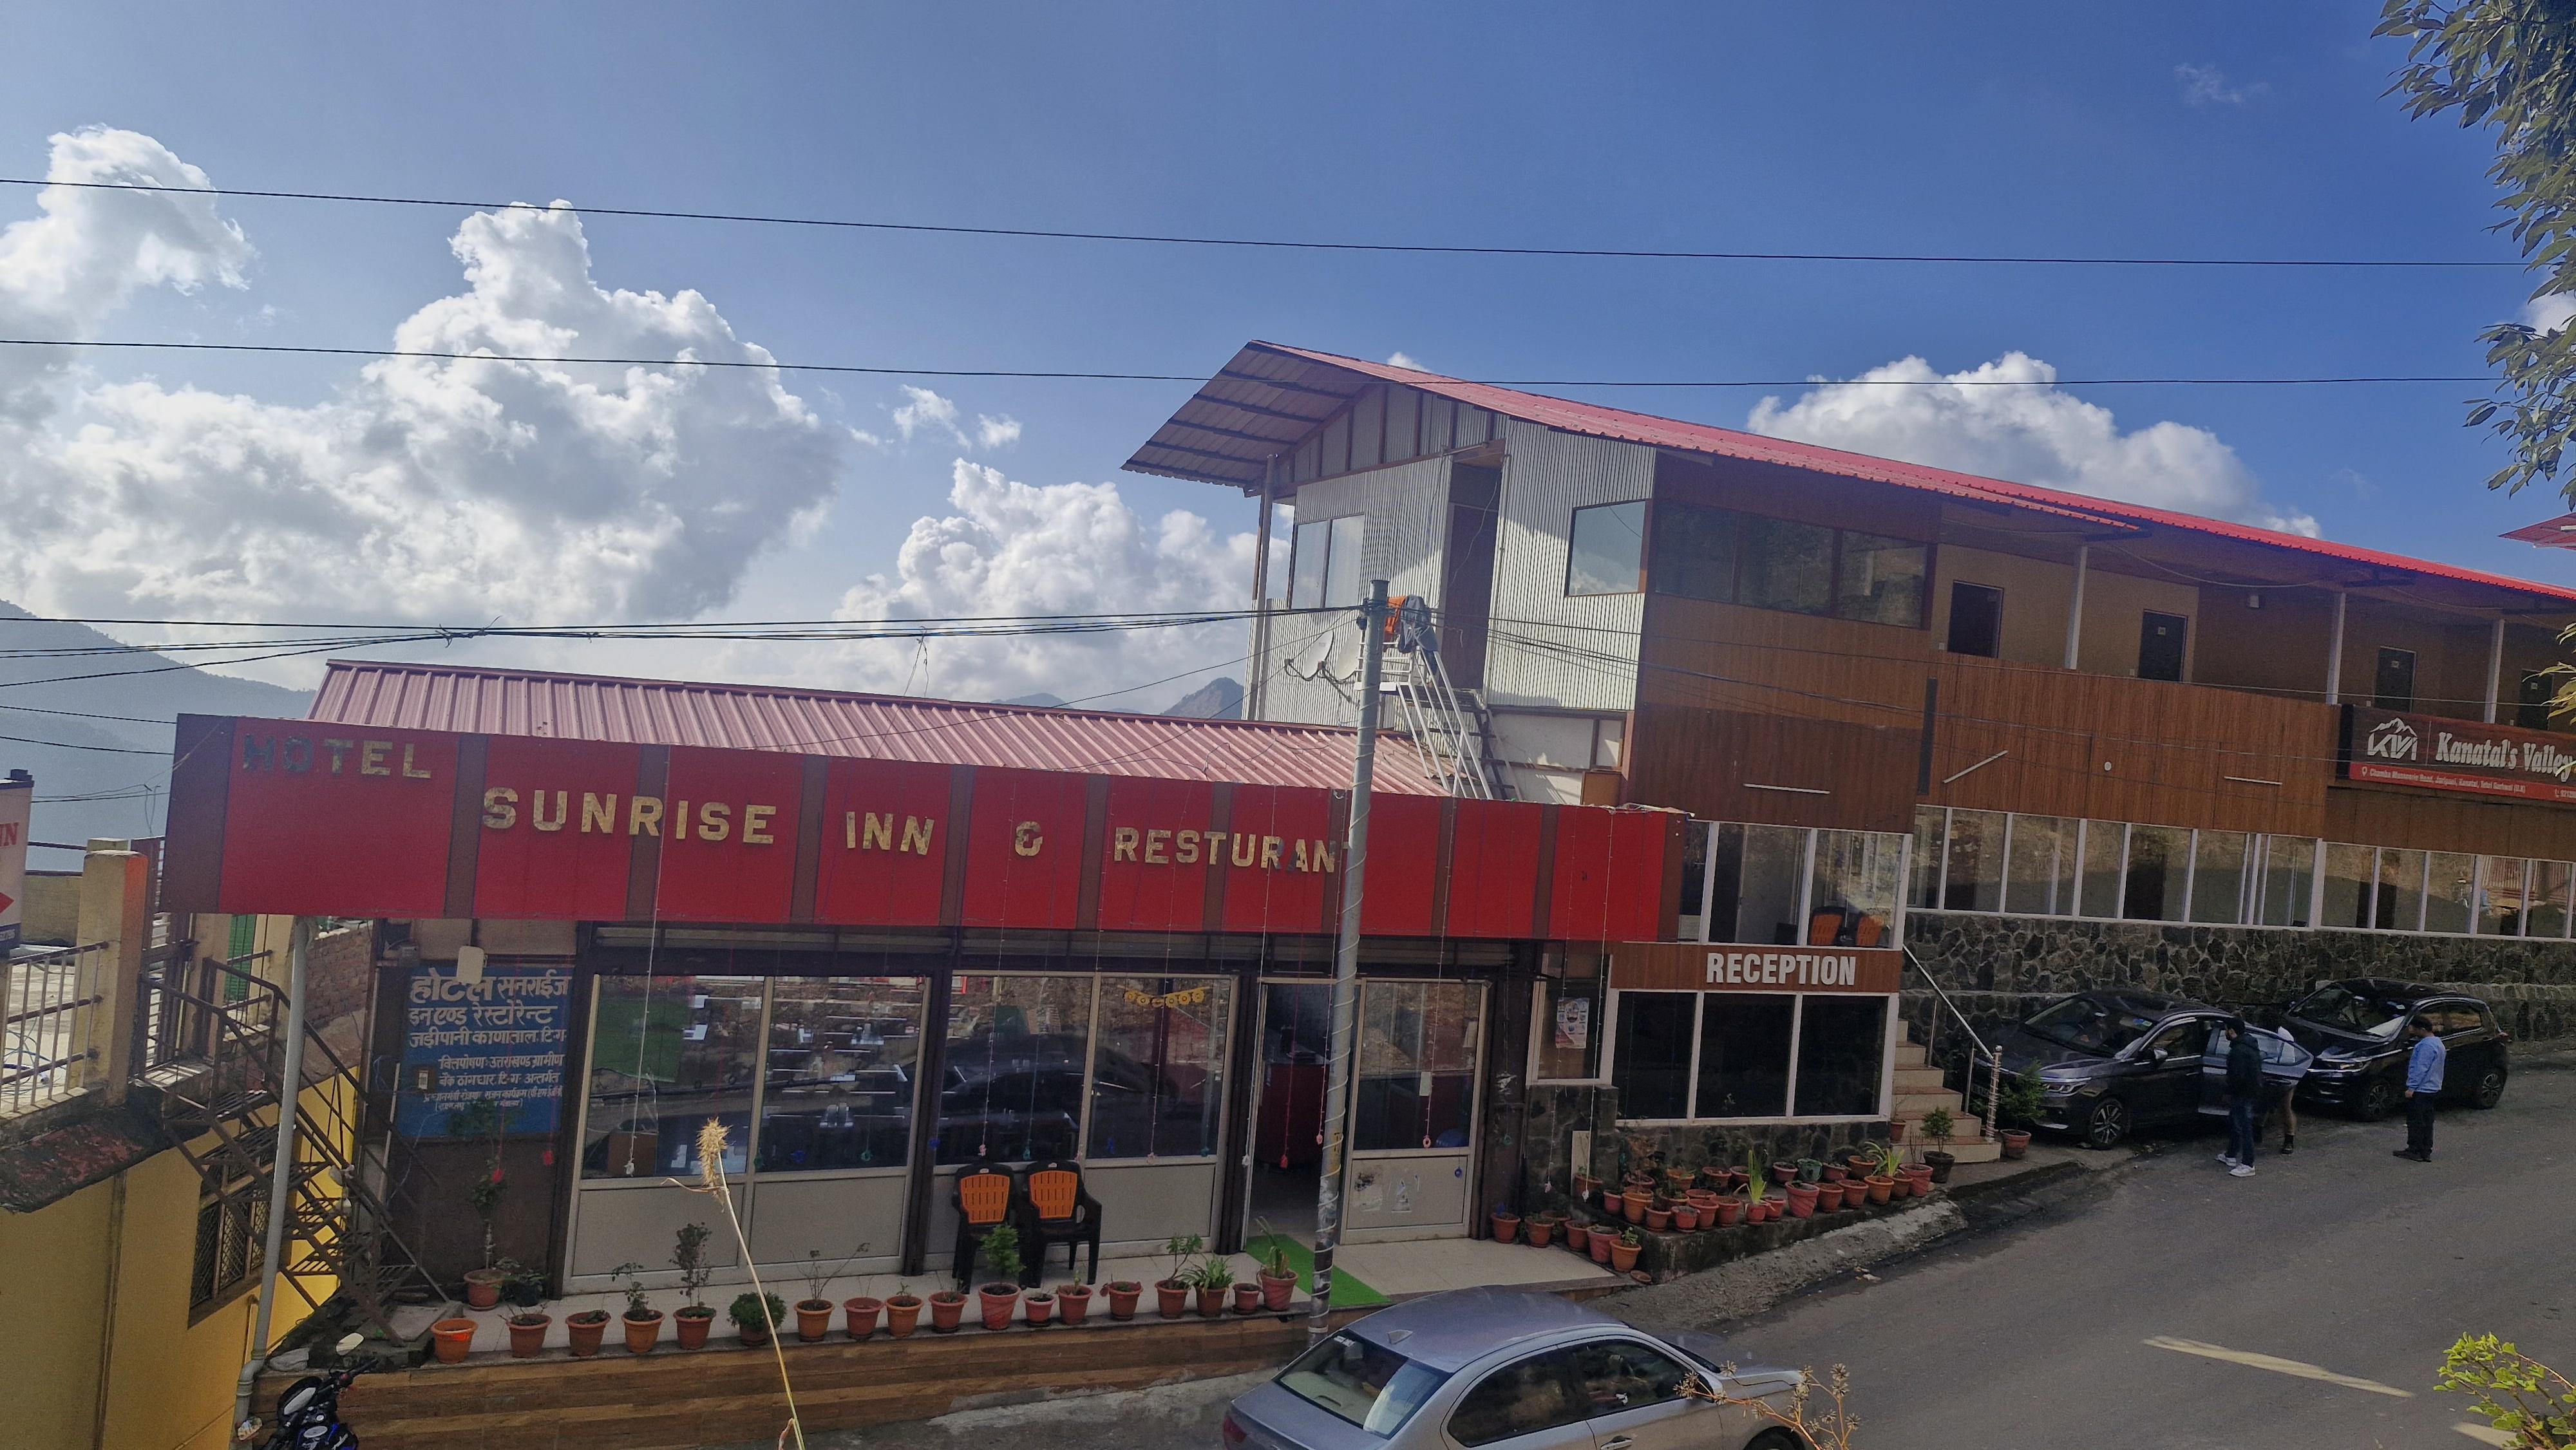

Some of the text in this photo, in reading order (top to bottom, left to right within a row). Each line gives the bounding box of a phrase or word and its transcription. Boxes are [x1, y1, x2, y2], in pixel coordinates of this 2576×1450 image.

[2436, 731, 2573, 782] Kanatal's Valley
[242, 733, 431, 778] HOTEL
[482, 787, 777, 844] SUNRISE
[846, 811, 935, 856] INN
[1113, 827, 1349, 873] RESTURAN
[410, 967, 573, 1004] होटल सनराईज
[1706, 952, 1856, 986] RECEPTION
[408, 1007, 433, 1026] इन
